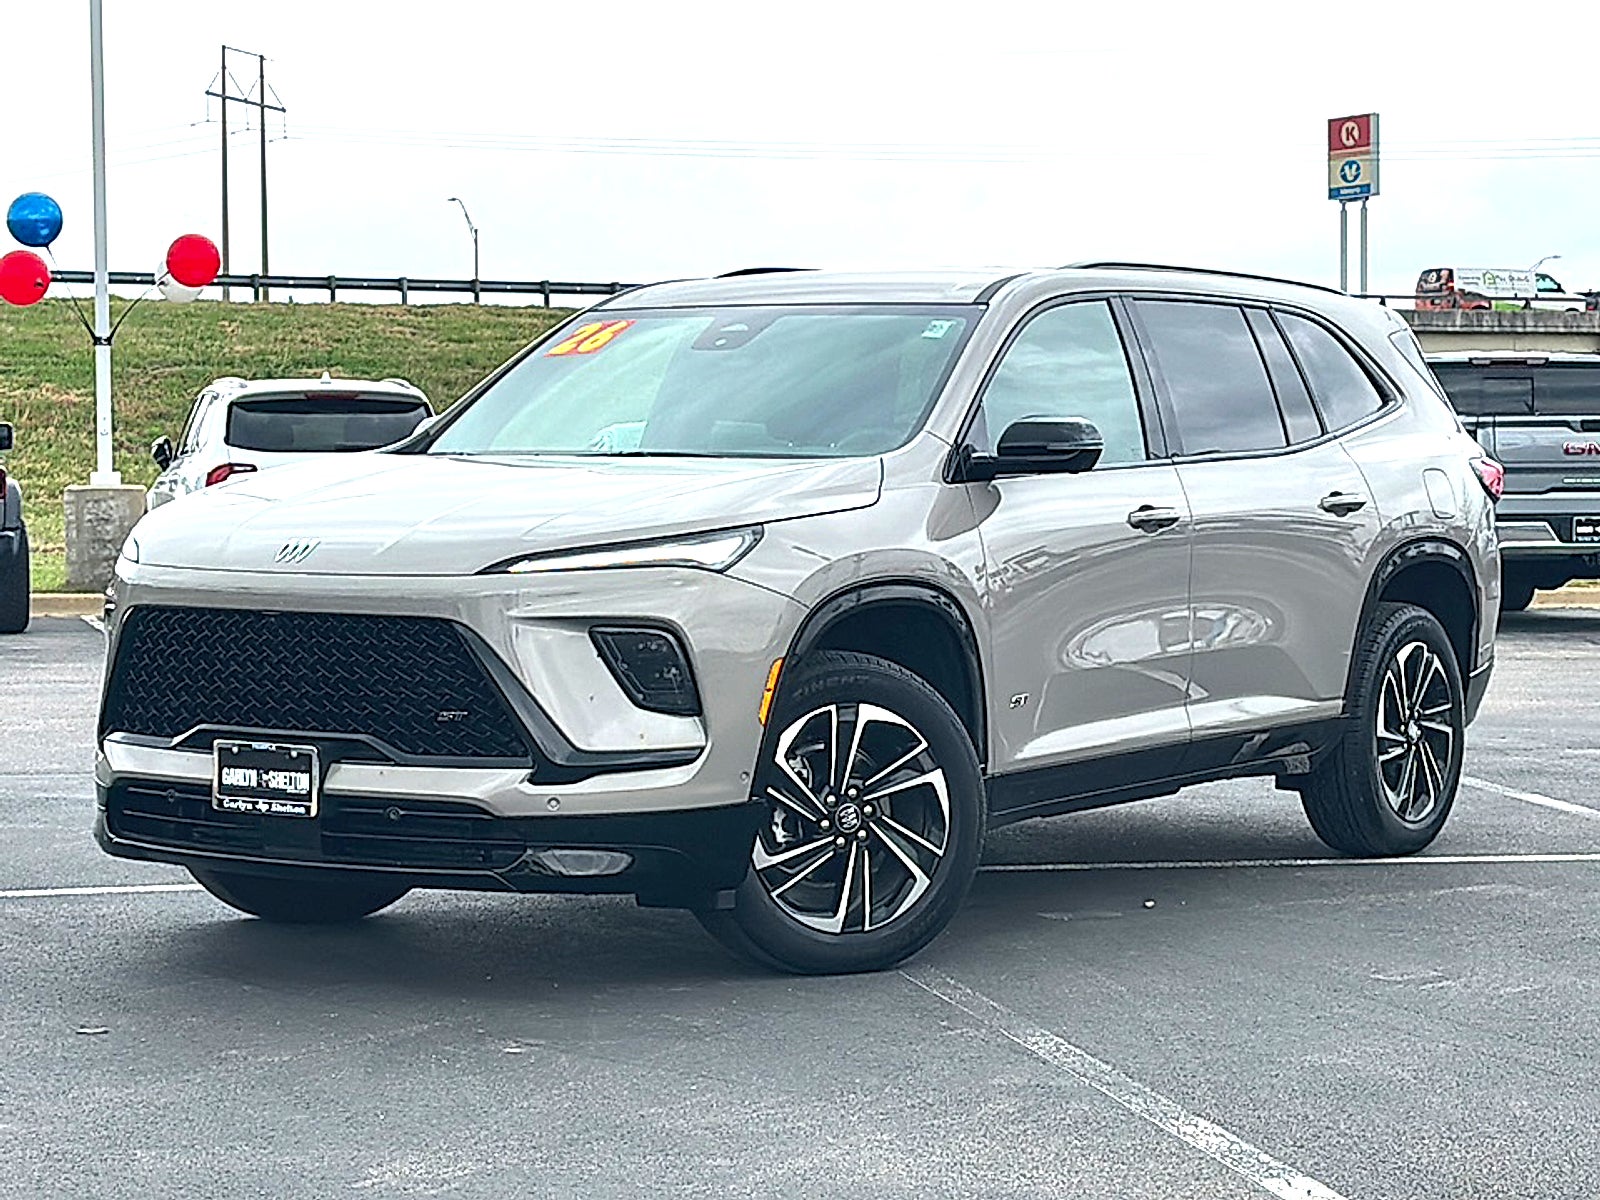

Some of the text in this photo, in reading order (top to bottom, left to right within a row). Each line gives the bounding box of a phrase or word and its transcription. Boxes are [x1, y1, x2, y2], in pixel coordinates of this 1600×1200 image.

[547, 321, 630, 355] 26
[1009, 692, 1030, 709] ST
[268, 770, 310, 790] SHELTON
